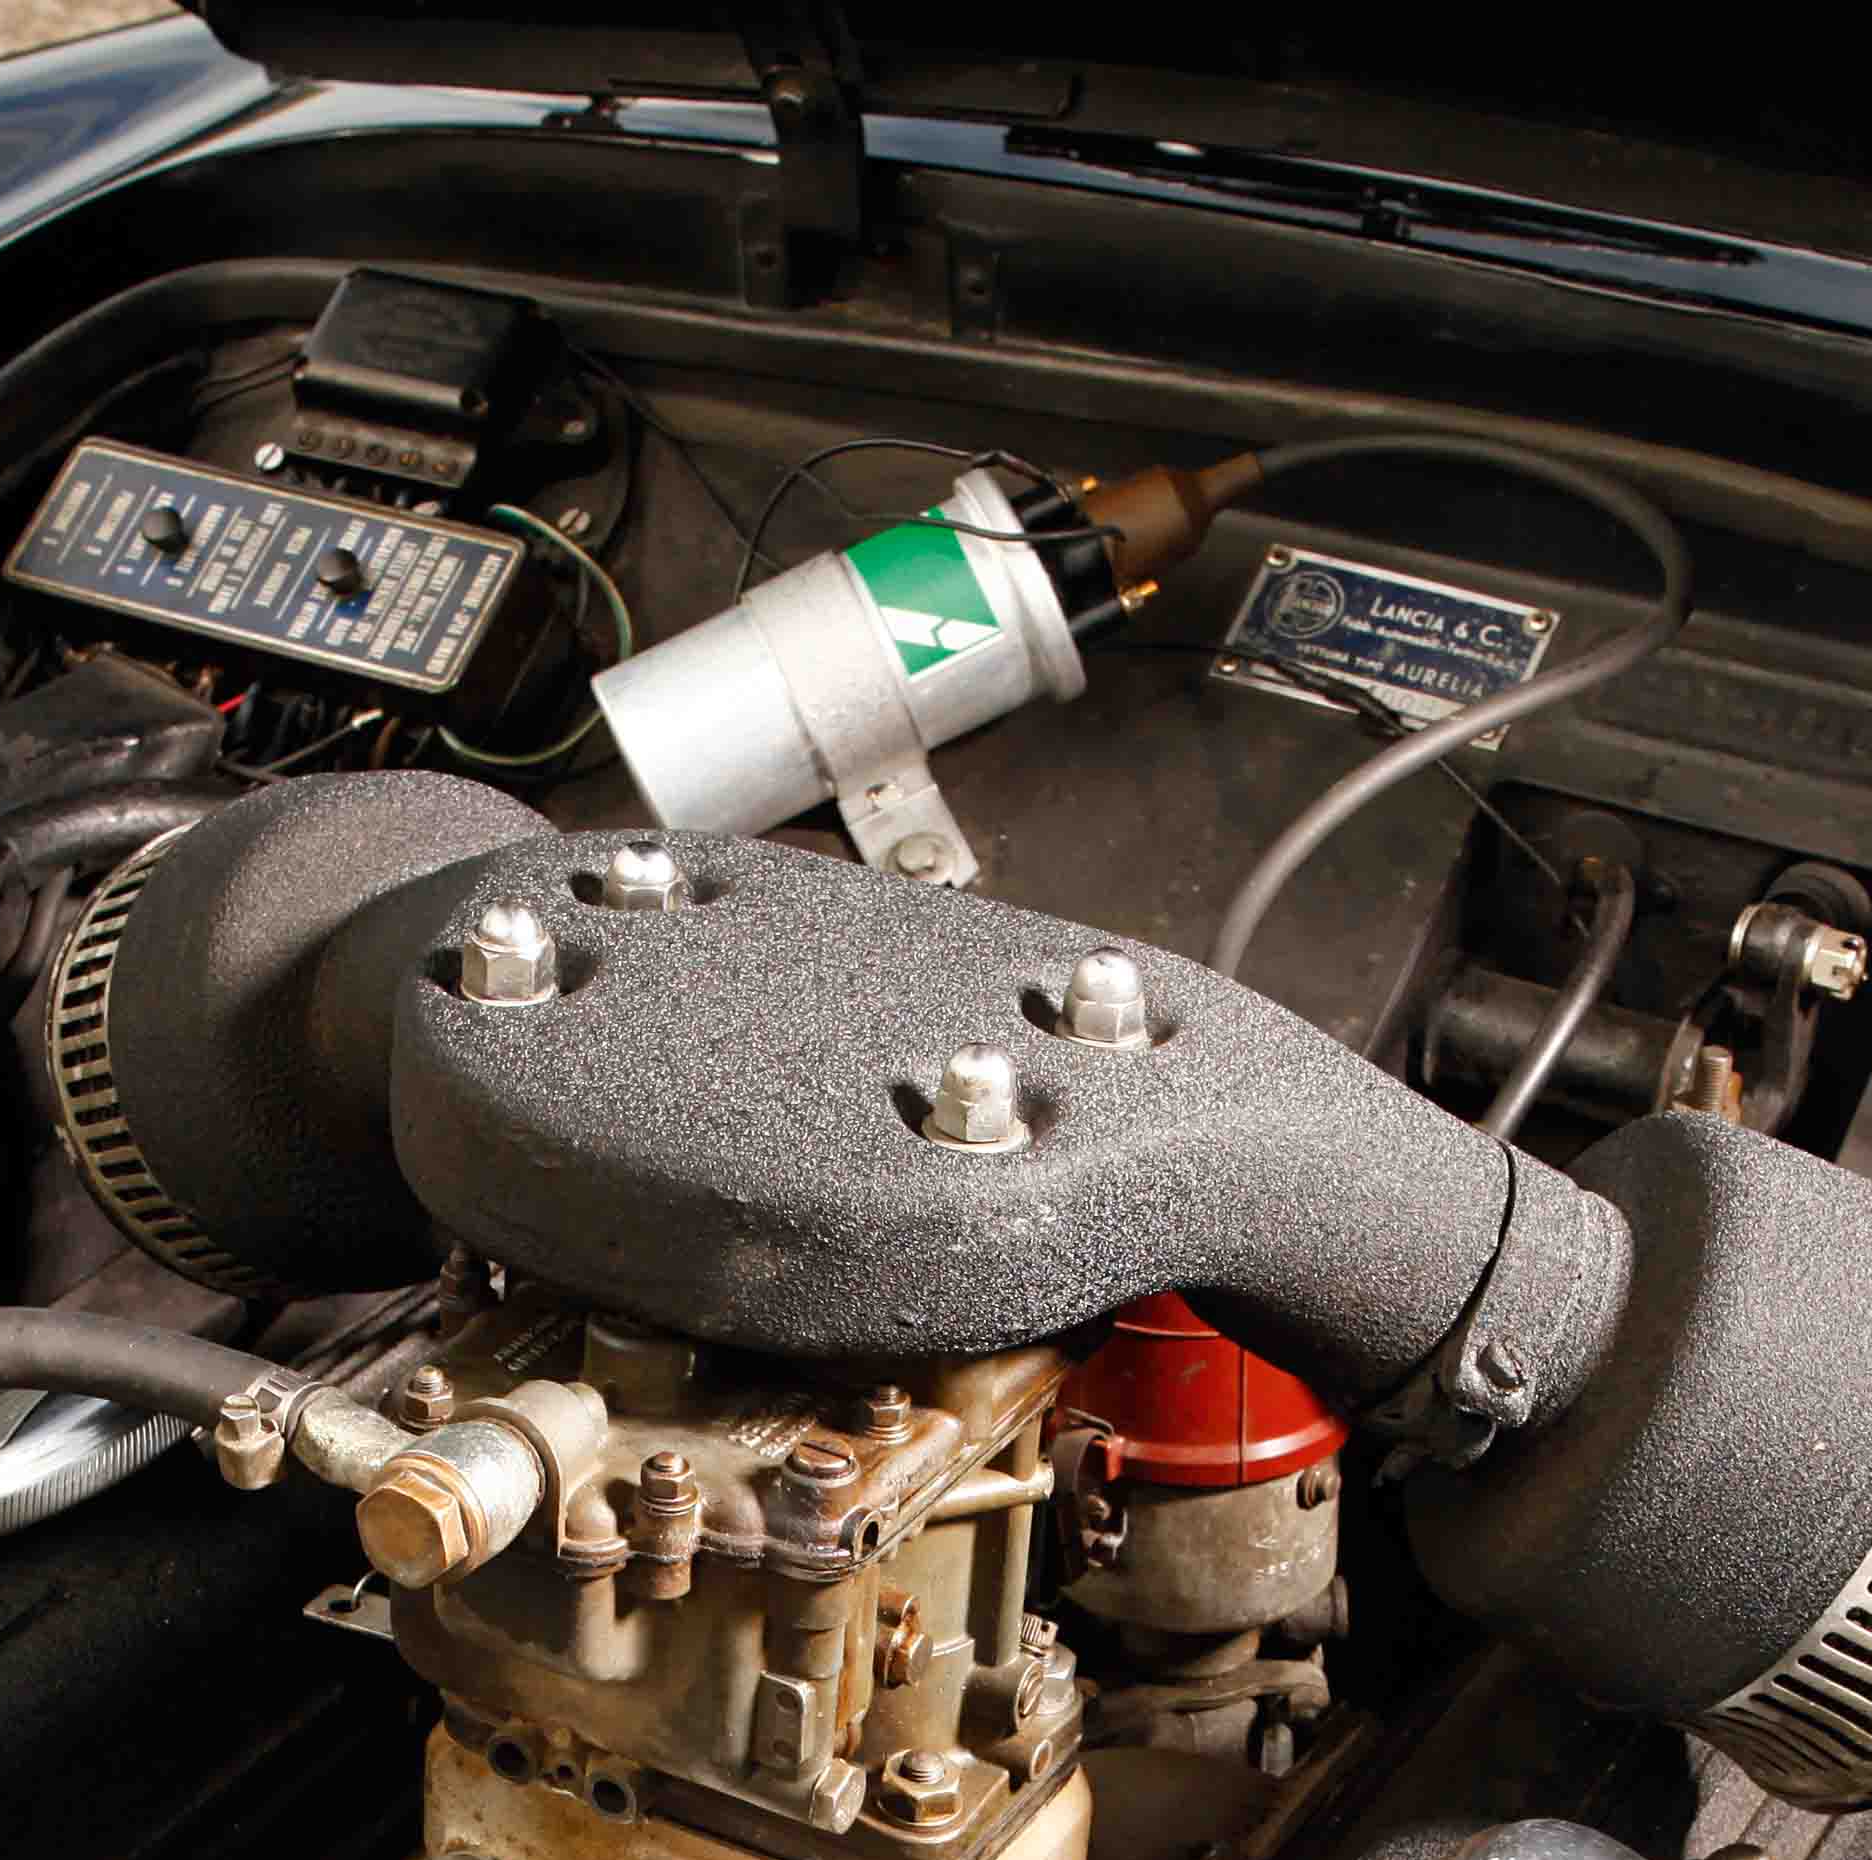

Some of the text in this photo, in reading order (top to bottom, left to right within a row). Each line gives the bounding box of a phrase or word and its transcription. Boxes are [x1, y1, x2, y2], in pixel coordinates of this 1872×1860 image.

[1370, 597, 1445, 633] LANCIA
[1479, 625, 1506, 648] C.
[1394, 664, 1487, 700] AURELIA
